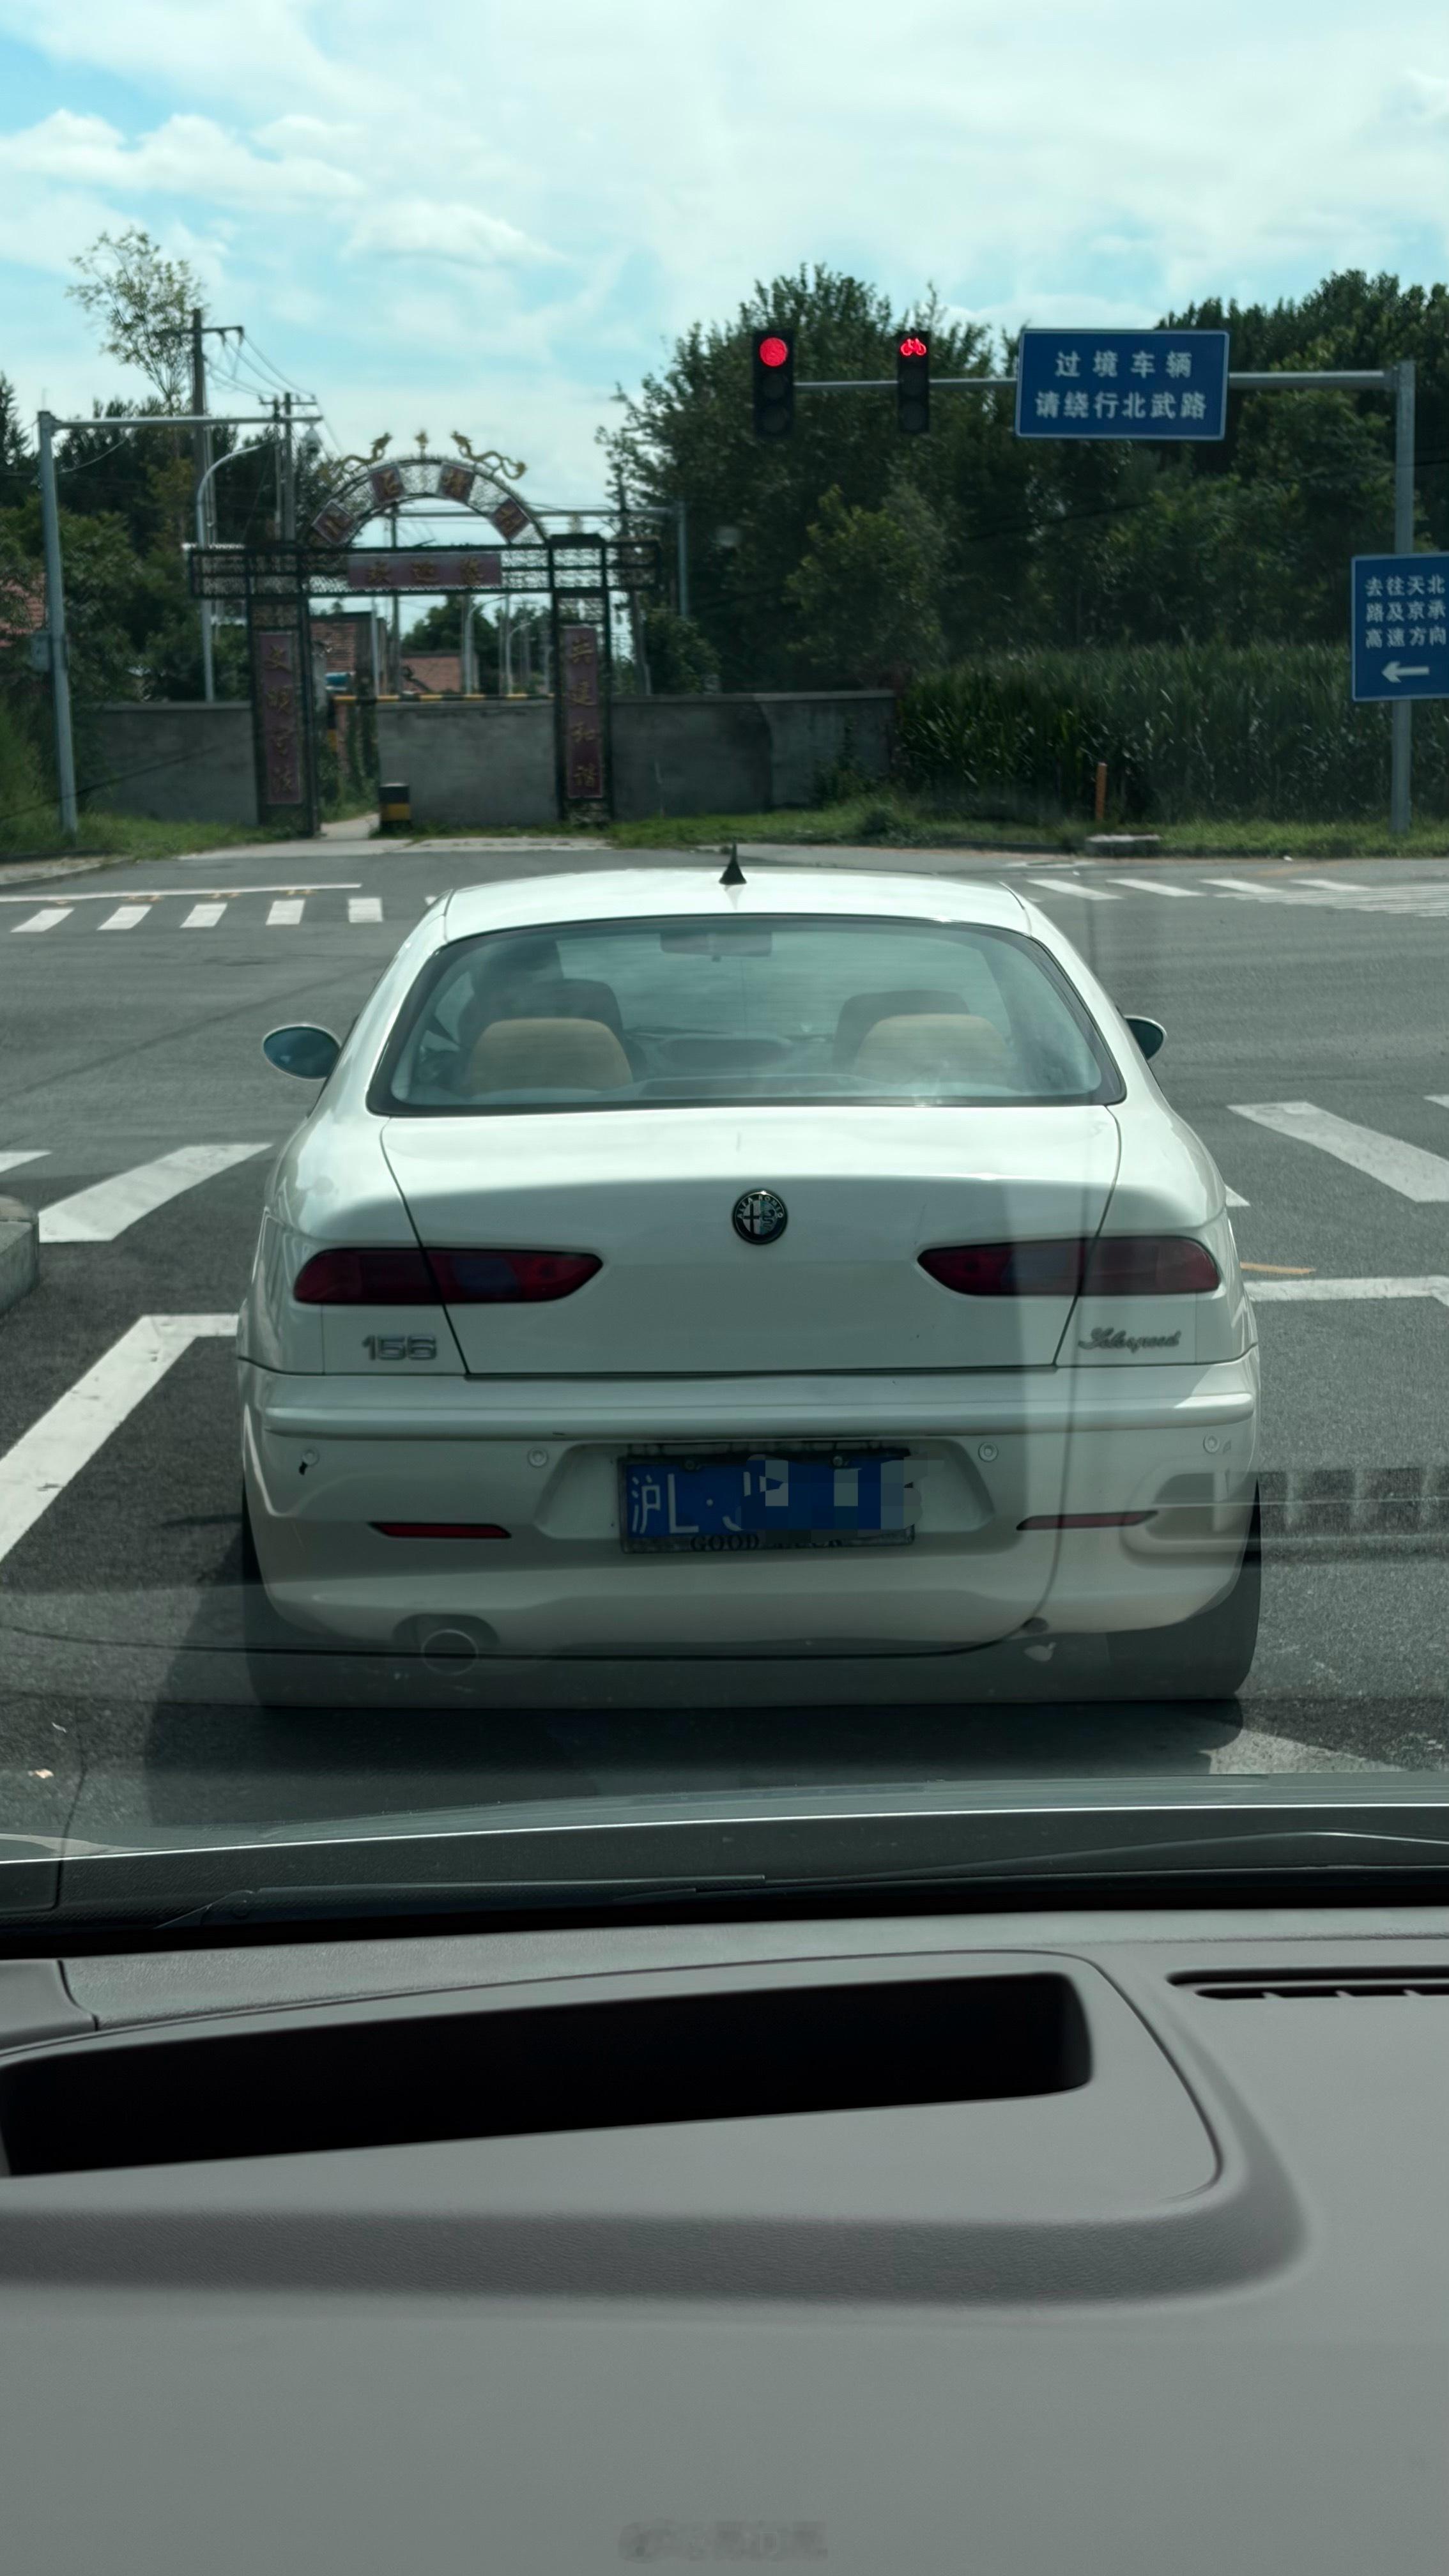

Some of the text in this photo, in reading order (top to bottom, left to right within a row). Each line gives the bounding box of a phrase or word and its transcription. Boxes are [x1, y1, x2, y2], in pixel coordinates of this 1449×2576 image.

[1055, 350, 1192, 378] 过境车辆
[1034, 390, 1207, 420] 请绕行北武路
[1365, 574, 1446, 597] 去往天北
[1365, 599, 1446, 623] 路及京承
[1365, 625, 1446, 649] 高速方向
[362, 1334, 437, 1361] 156
